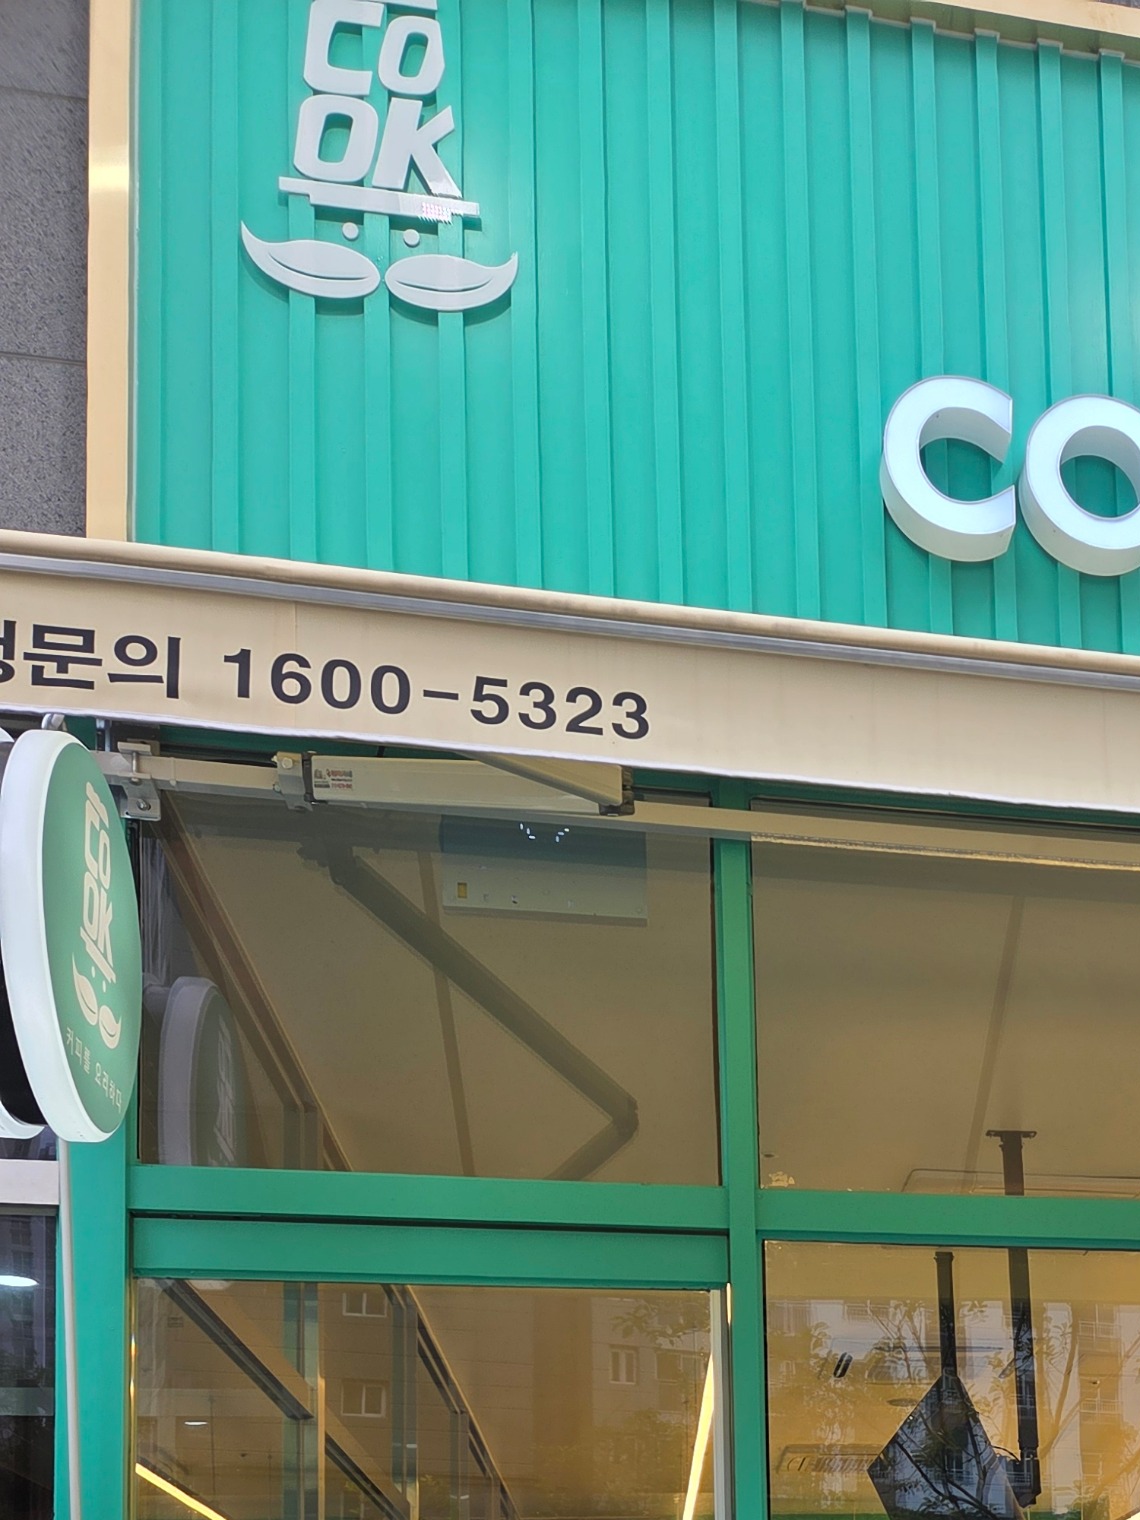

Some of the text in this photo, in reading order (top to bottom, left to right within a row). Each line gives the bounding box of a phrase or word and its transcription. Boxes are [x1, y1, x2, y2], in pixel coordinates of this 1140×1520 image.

[222, 645, 651, 741] 1600-5323
[65, 1025, 124, 1115] 커피를 요리하다
